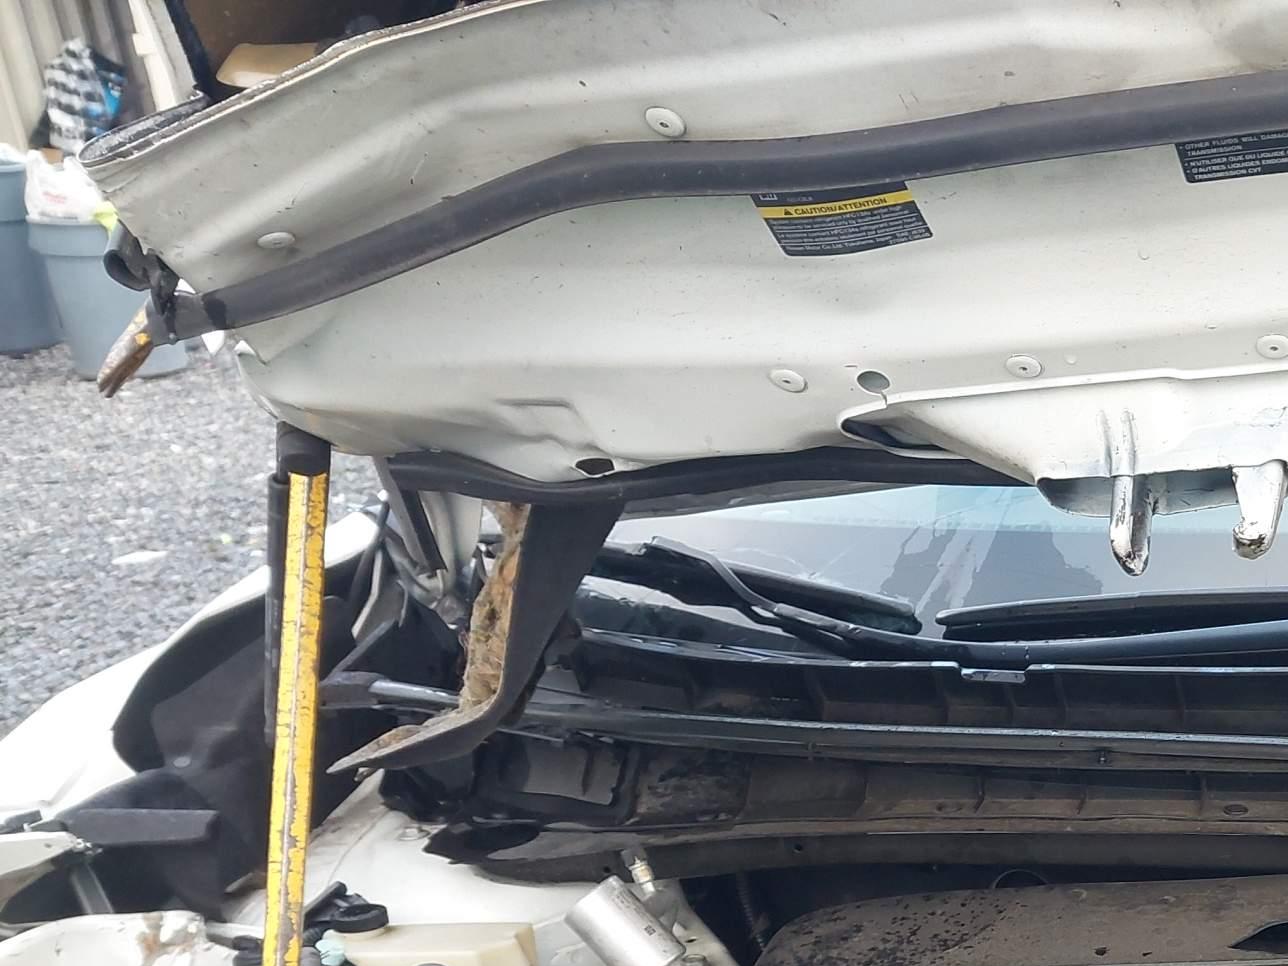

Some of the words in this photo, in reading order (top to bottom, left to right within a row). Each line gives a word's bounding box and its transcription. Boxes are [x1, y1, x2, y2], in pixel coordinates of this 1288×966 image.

[1188, 145, 1242, 156] TRANSMISSION
[1194, 169, 1246, 180] TRANSMISSION
[795, 197, 887, 215] CAUTION/ATTENTION
